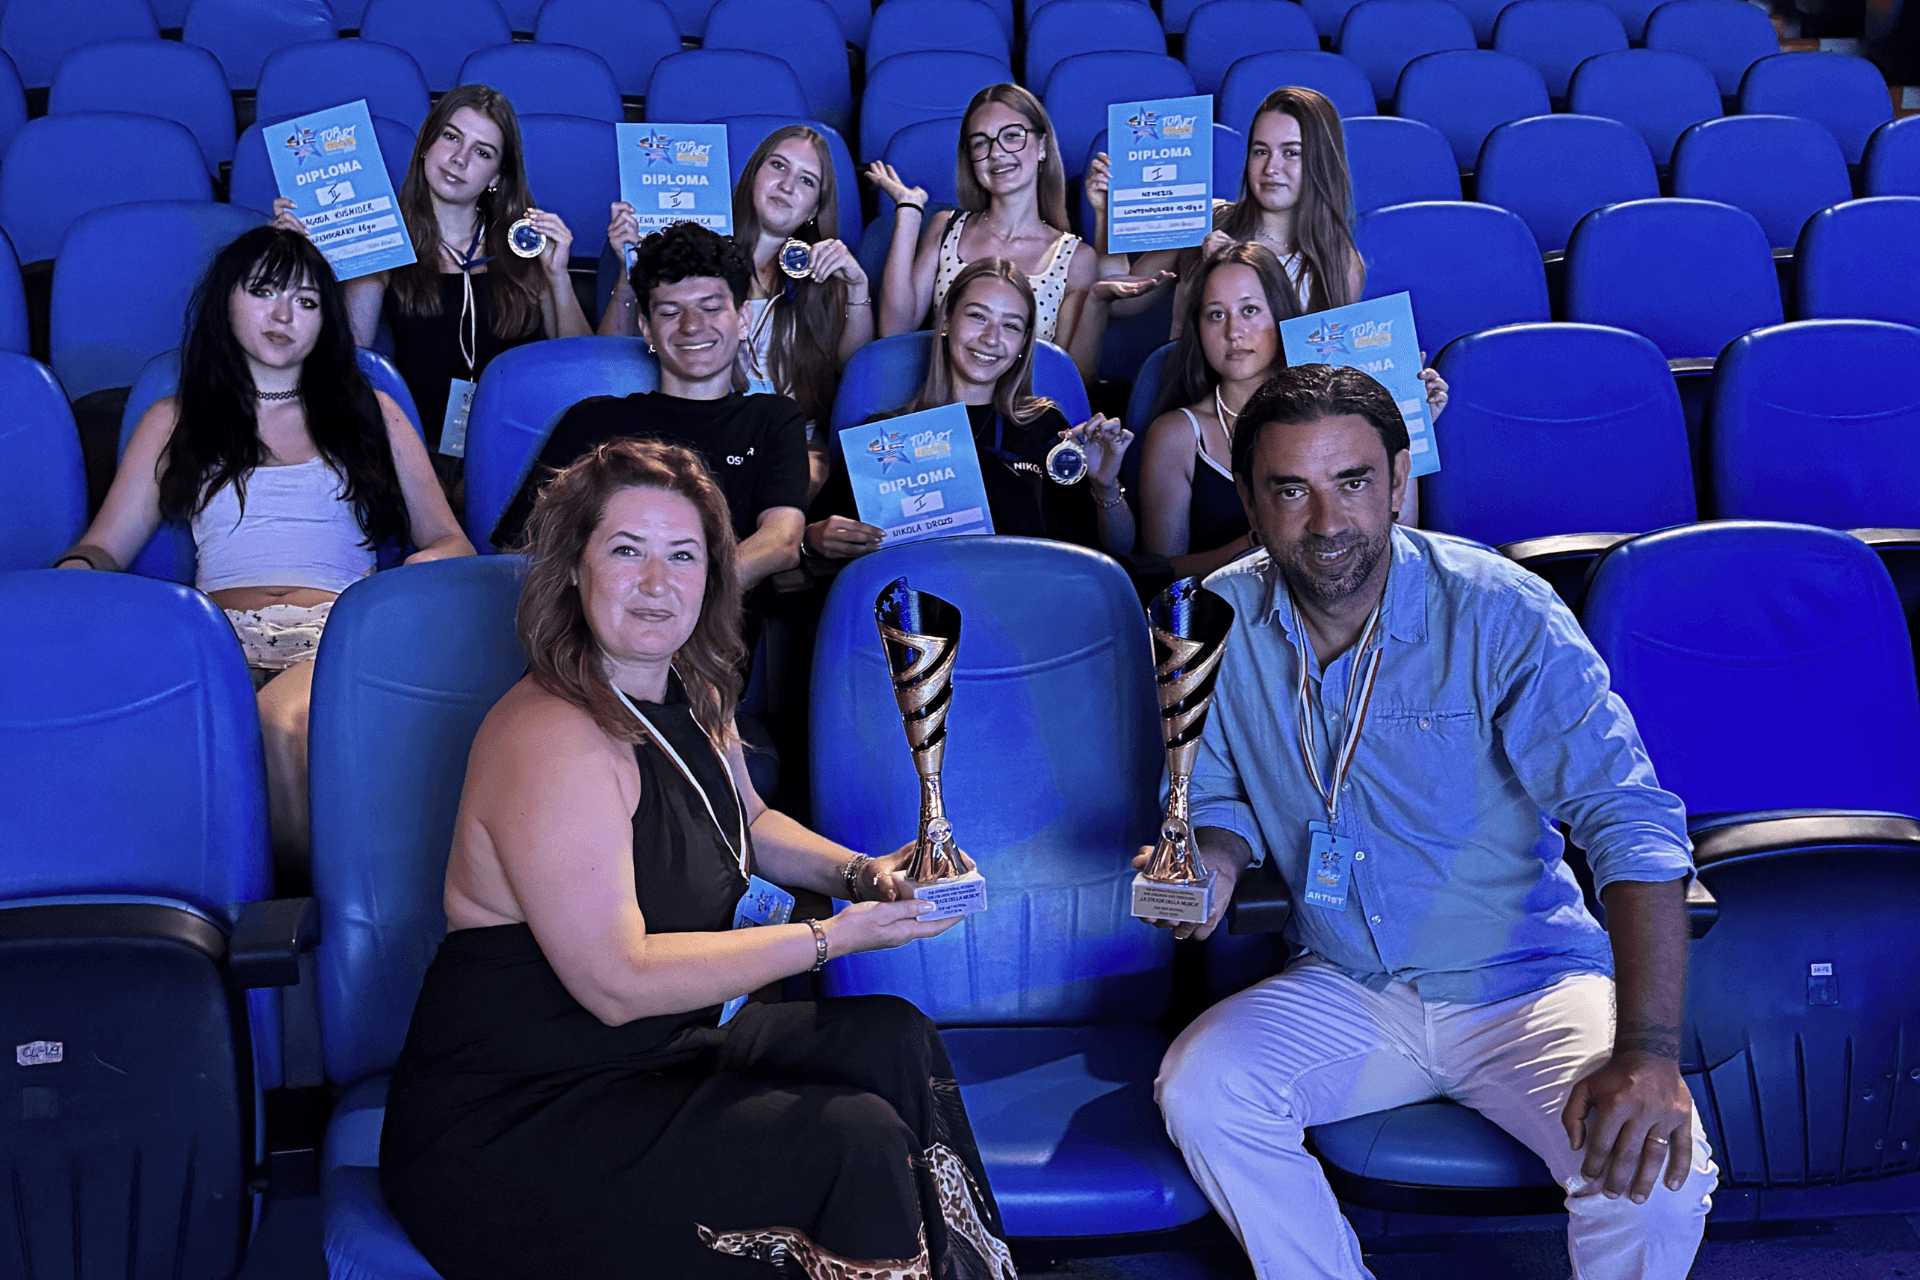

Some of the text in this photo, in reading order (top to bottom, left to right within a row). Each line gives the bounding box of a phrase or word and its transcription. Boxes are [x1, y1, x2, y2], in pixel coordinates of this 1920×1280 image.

[1128, 146, 1192, 161] DIPLOMA
[296, 159, 362, 186] DIPLOMA
[642, 174, 709, 186] DIPLOMA
[304, 214, 330, 226] AGODA
[638, 216, 655, 225] ENA
[878, 467, 956, 495] DIPLOMA
[892, 523, 922, 538] NIKOLA
[1307, 891, 1344, 905] ARTIST
